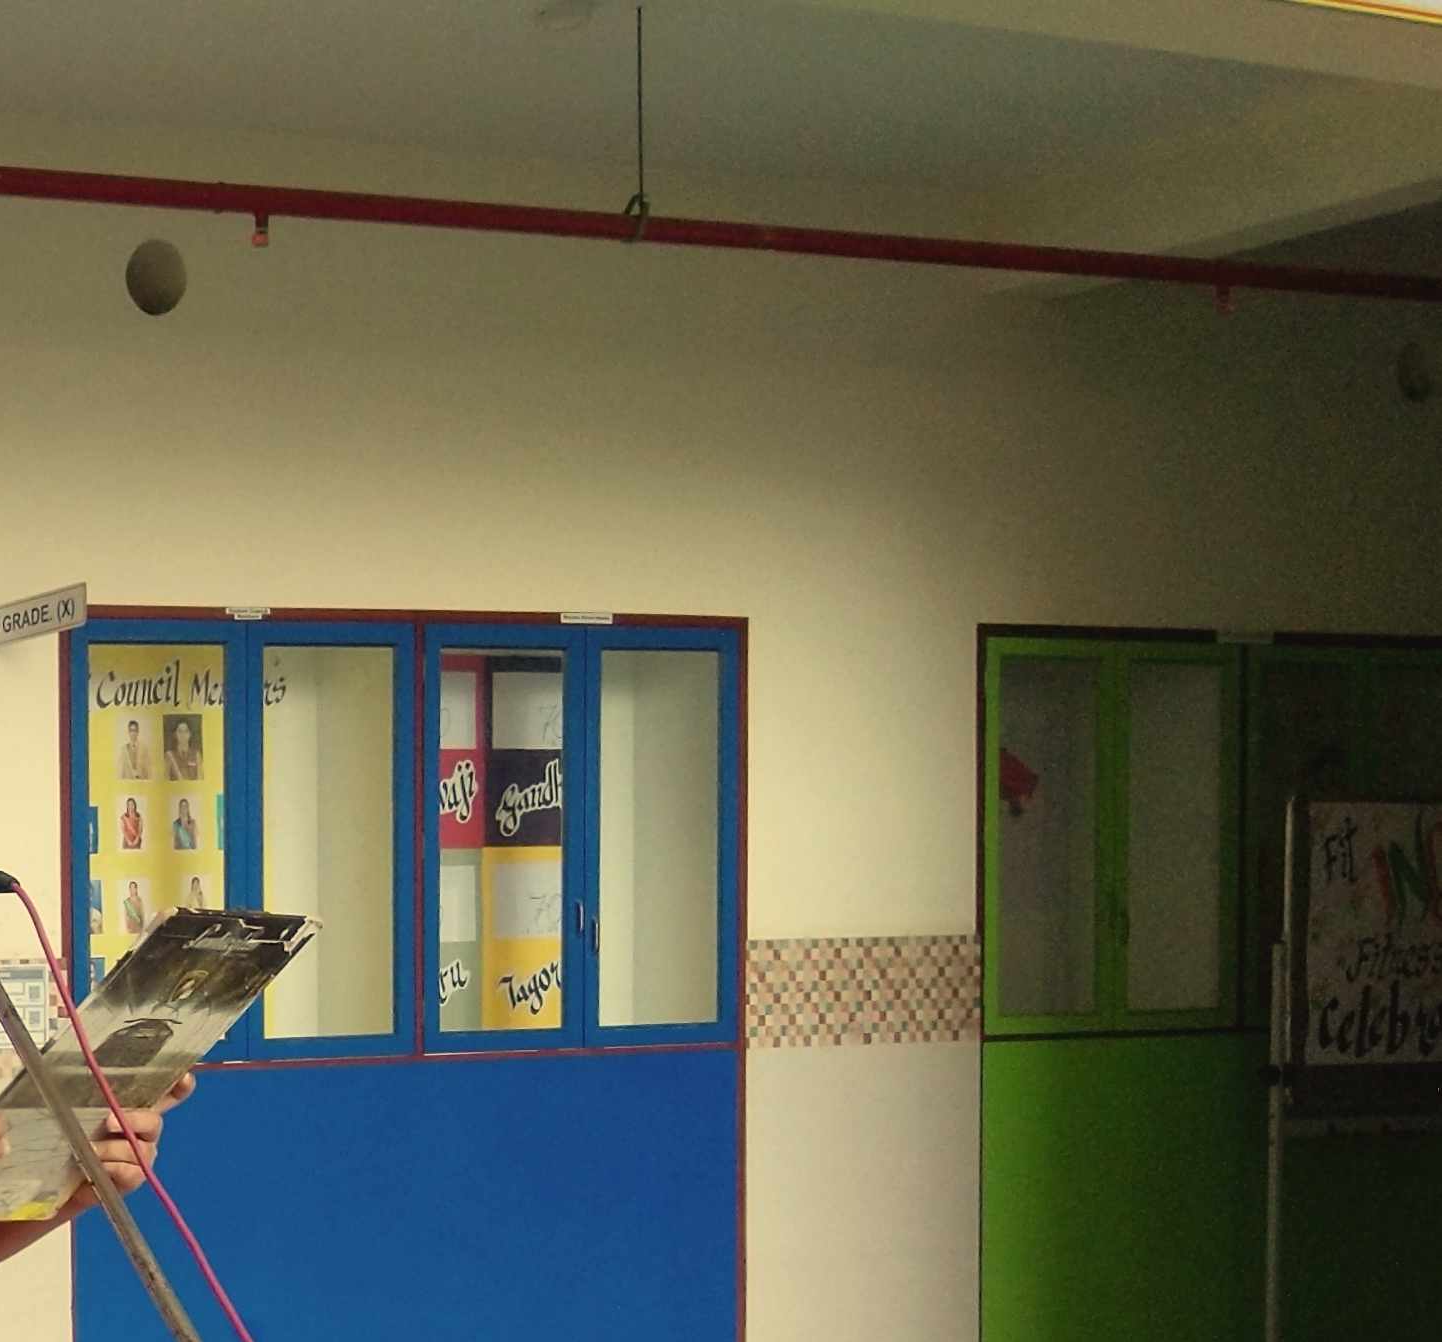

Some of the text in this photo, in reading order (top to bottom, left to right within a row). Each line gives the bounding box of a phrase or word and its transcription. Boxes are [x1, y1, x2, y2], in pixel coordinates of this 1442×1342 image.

[2, 598, 76, 633] GRADE. (X)
[95, 658, 180, 709] Council
